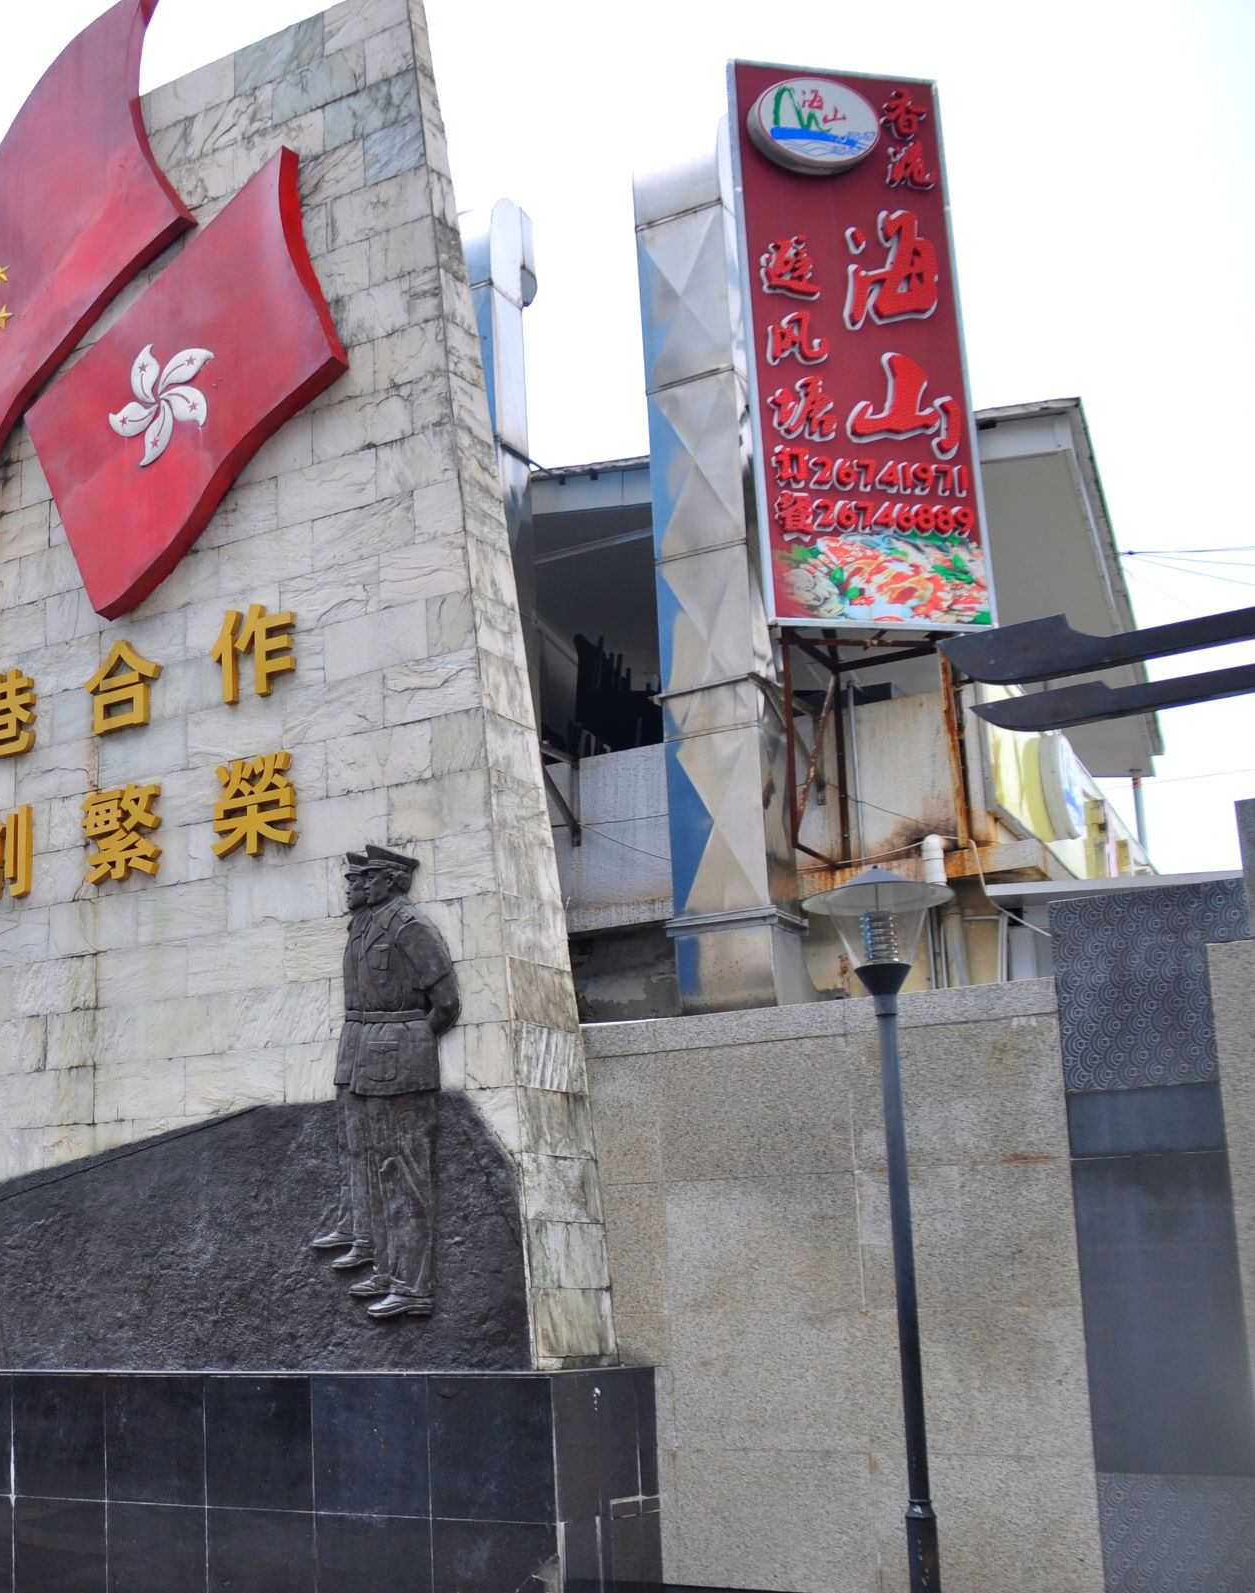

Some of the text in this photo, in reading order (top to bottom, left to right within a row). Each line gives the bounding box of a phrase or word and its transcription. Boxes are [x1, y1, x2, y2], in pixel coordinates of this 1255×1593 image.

[880, 88, 937, 190] 香港
[845, 209, 961, 459] 海山
[809, 455, 969, 497] 26741971
[813, 498, 975, 539] 26746889
